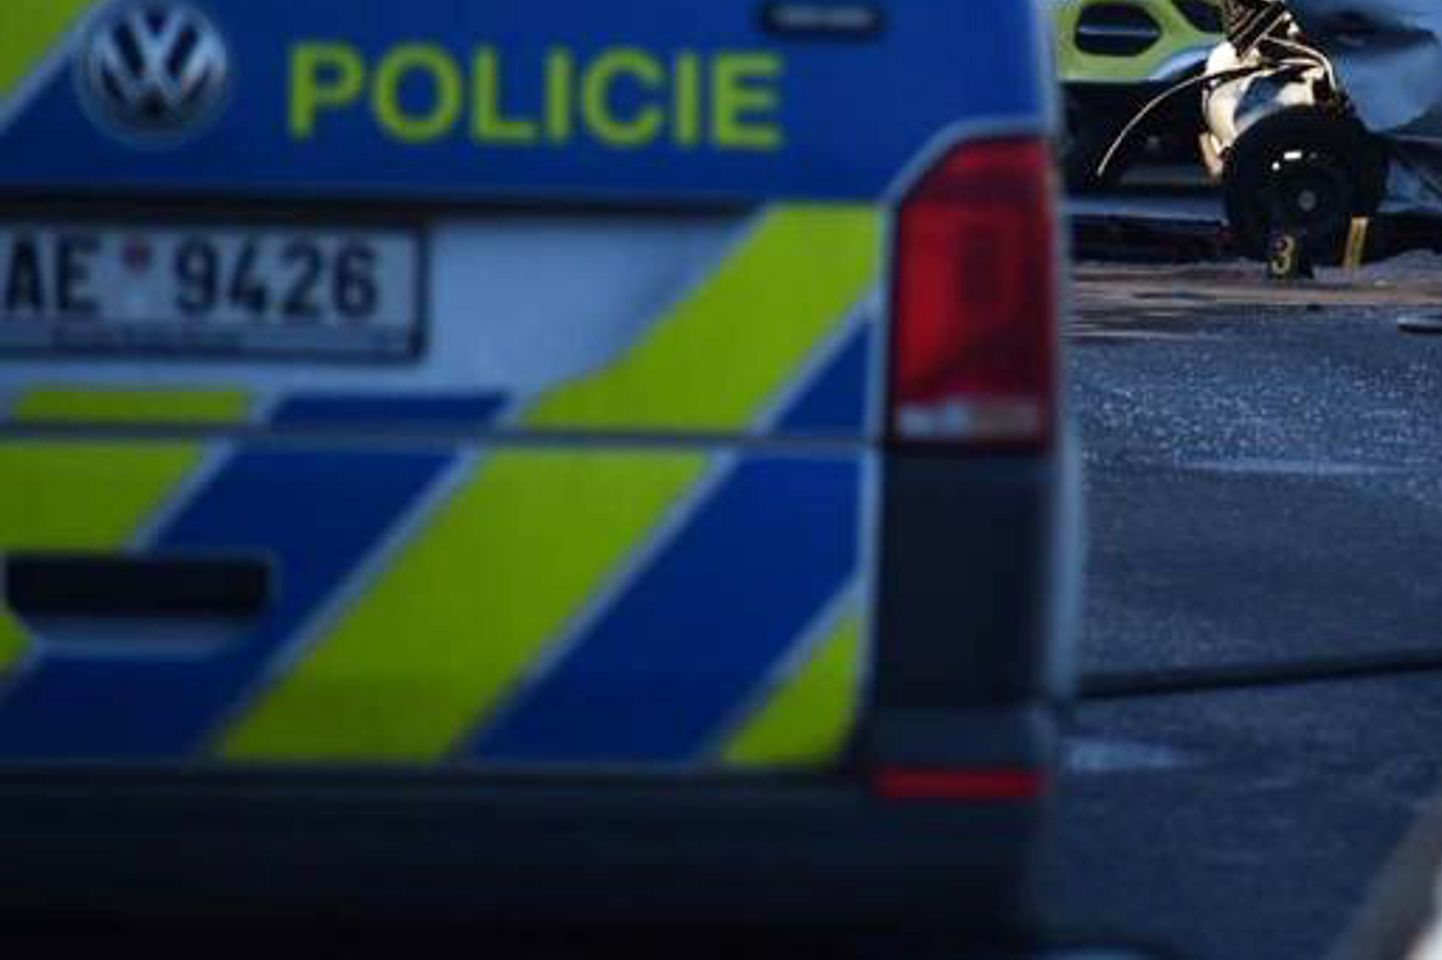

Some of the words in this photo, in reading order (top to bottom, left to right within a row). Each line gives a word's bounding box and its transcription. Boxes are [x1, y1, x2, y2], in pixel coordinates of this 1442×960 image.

[287, 43, 783, 149] POLICIE
[3, 234, 99, 312] AE
[173, 234, 381, 318] 9426
[1270, 236, 1295, 274] 3
